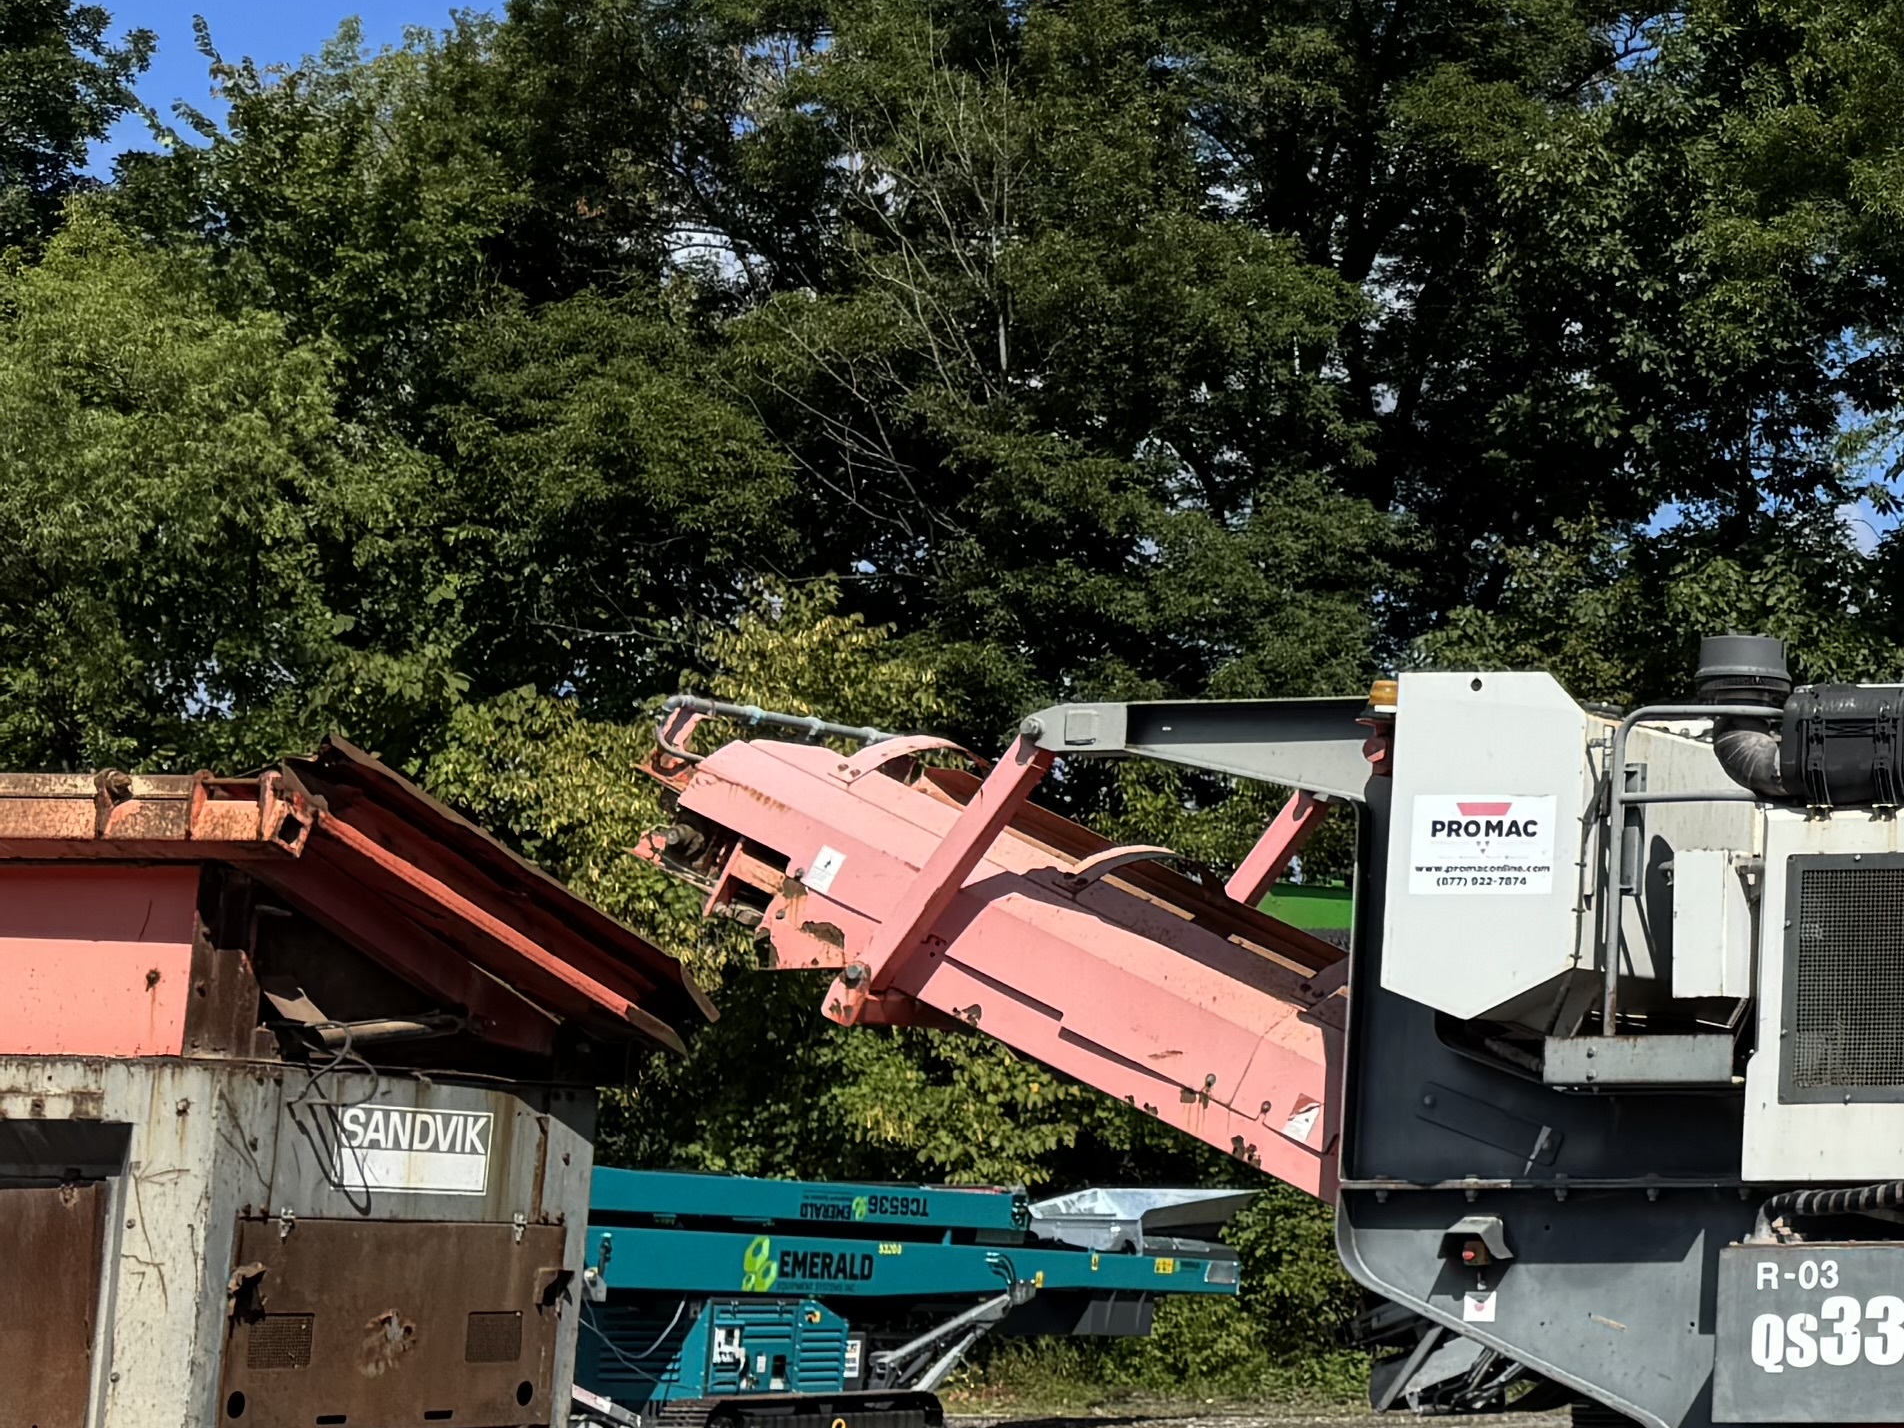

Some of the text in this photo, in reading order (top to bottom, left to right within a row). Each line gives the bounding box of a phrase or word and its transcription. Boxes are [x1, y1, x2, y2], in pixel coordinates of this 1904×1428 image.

[1436, 877, 1468, 887] (877)
[341, 1108, 488, 1154] SANDVIK
[800, 1203, 851, 1220] EMERALD
[778, 1250, 874, 1281] EMERALD
[1756, 1260, 1839, 1290] R-03
